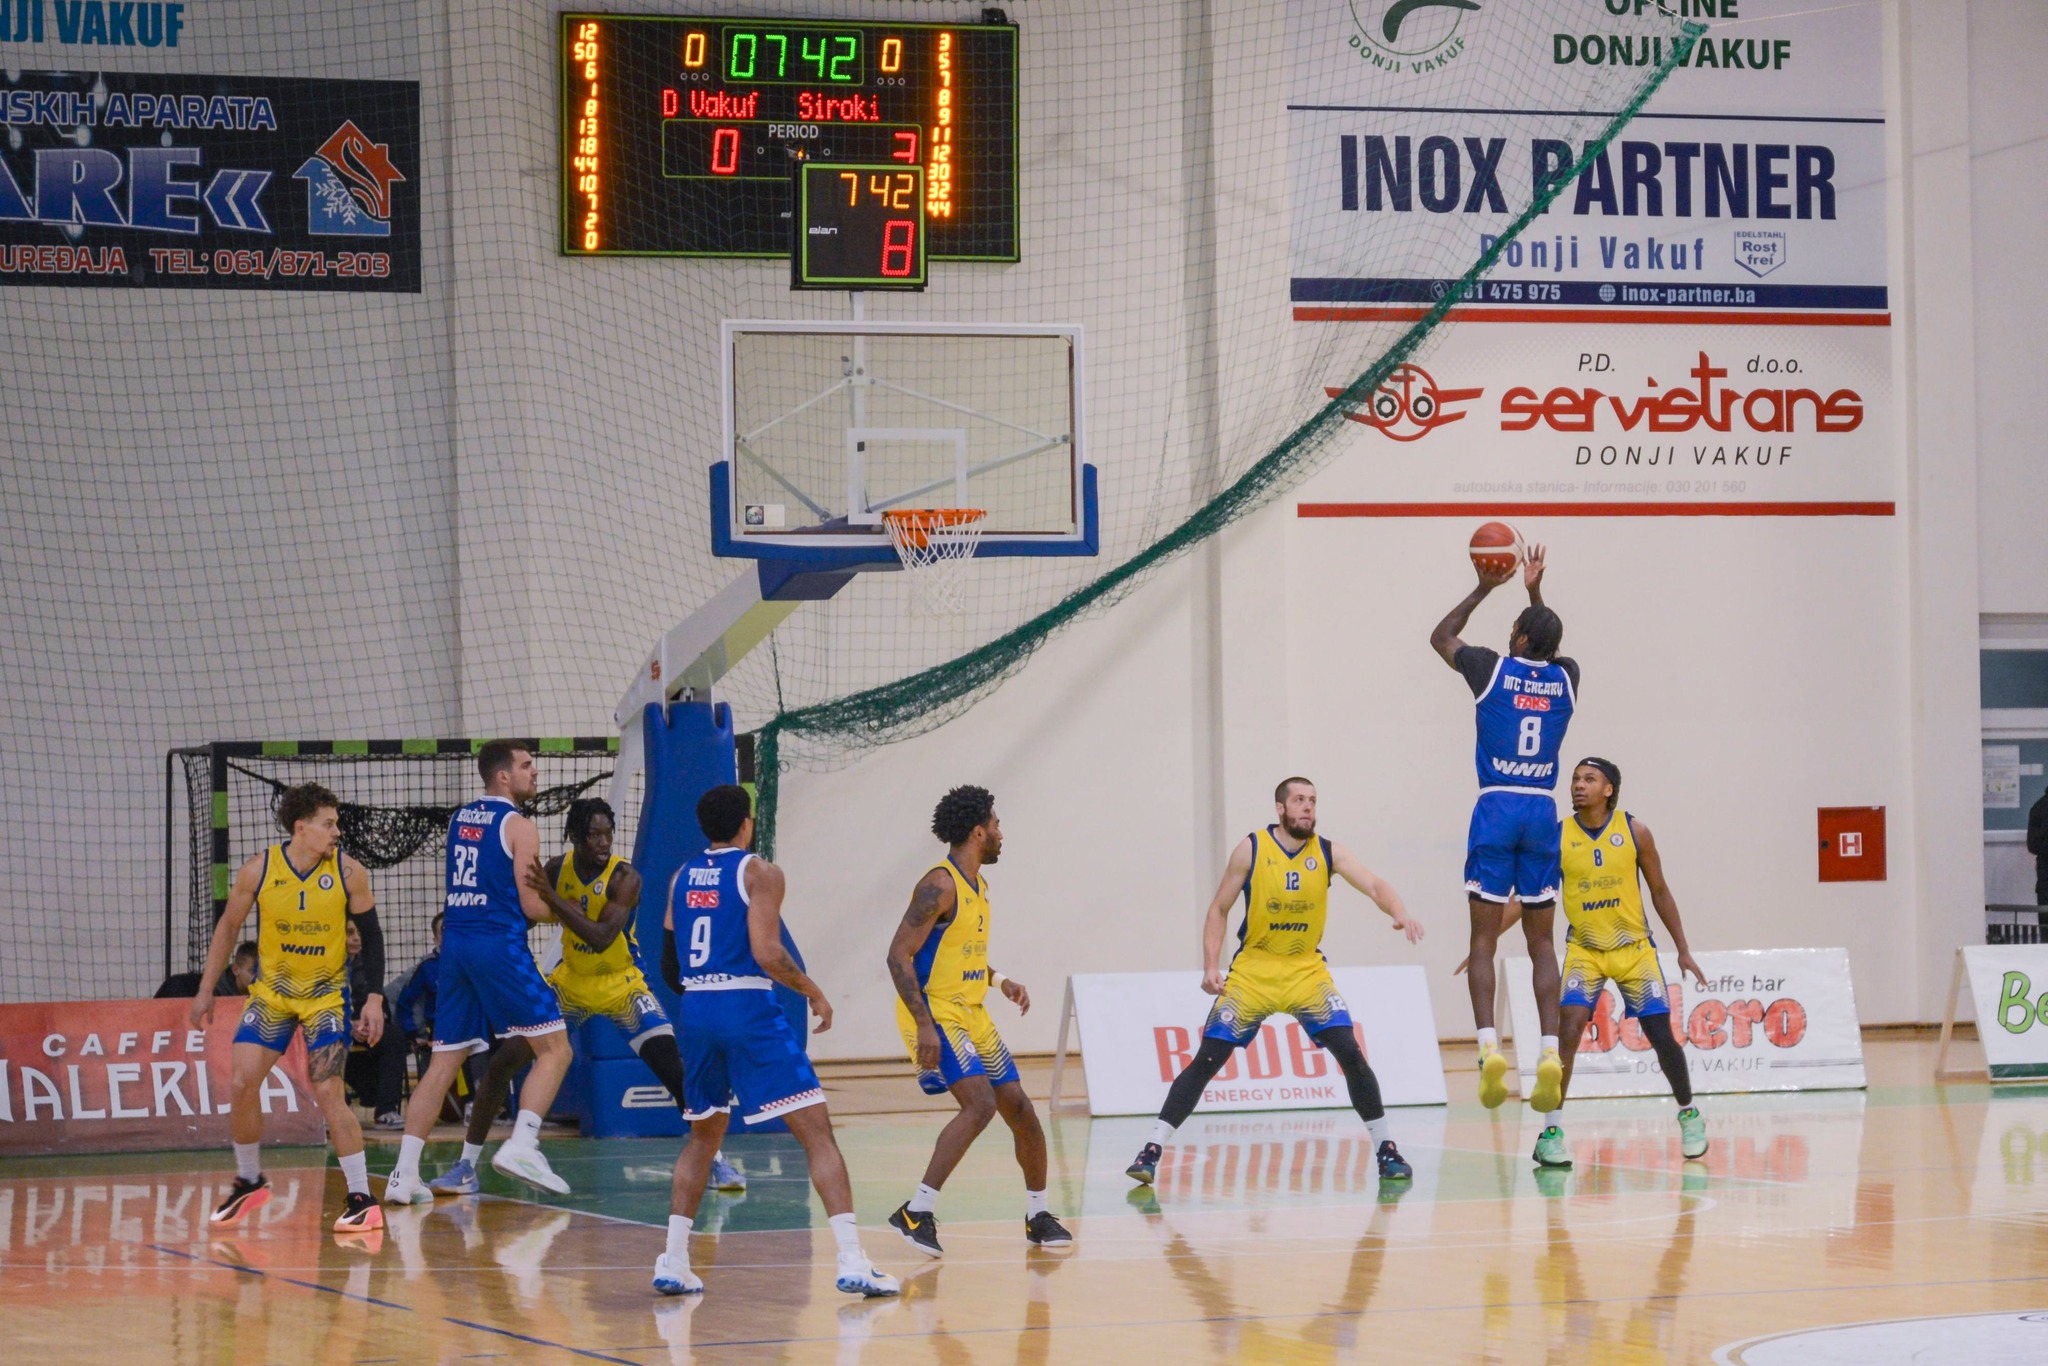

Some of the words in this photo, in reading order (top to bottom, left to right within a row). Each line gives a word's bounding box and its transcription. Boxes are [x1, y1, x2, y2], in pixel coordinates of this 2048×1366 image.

[54, 0, 184, 47] VAKUF
[580, 23, 598, 41] 12
[573, 42, 597, 61] 50
[939, 33, 951, 52] 3
[1553, 33, 1662, 67] DONJI
[1670, 36, 1791, 70] VAKUF
[685, 33, 705, 66] 0
[881, 39, 901, 72] 0
[938, 51, 950, 70] 5
[1348, 35, 1400, 73] DONJI
[1411, 37, 1467, 74] VAKUF
[585, 61, 597, 80] 6
[940, 70, 951, 87] 7
[663, 89, 678, 117] D
[690, 89, 759, 119] Vakuf
[799, 92, 880, 122] Siroki
[938, 88, 951, 107] 8
[104, 93, 277, 131] APARATA
[585, 99, 598, 117] 8
[939, 107, 951, 126] 9
[580, 118, 598, 136] 13
[768, 124, 819, 139] PERIOD
[580, 137, 598, 155] 18
[711, 129, 740, 173] 0
[933, 144, 951, 162] 12
[573, 157, 598, 172] 44
[928, 163, 951, 181] 30
[580, 175, 598, 192] 10
[1340, 134, 1508, 214] INOX
[1532, 138, 1837, 220] PARTNER
[928, 181, 951, 200] 32
[587, 193, 598, 210] 7
[927, 201, 951, 217] 44
[585, 212, 598, 230] 2
[808, 226, 838, 235] elan
[585, 231, 598, 250] 0
[1736, 230, 1784, 239] EDELSTAHL
[881, 220, 915, 276] 8
[1480, 233, 1579, 273] Donji
[1599, 236, 1705, 270] Vakuf
[1742, 241, 1777, 252] Rost
[150, 248, 209, 274] TEL:
[214, 248, 390, 280] 061/871-203
[1747, 253, 1773, 265] frei
[1490, 284, 1523, 300] 475
[1528, 284, 1561, 300] 975
[1622, 283, 1756, 305] inox-partner.ba
[1577, 352, 1616, 373] P.D.
[1746, 354, 1804, 374] d.o.o.
[1501, 351, 1864, 432] servistrans
[1575, 446, 1674, 466] DONJI
[1694, 446, 1793, 466] VAKUF
[1453, 480, 1523, 494] autobuska
[1666, 481, 1690, 493] 030
[1694, 481, 1717, 493] 201
[1722, 481, 1746, 493] 560
[1513, 695, 1551, 711] FAKS
[1518, 716, 1542, 757] 8
[453, 845, 479, 887] 32
[1594, 849, 1603, 867] 8
[1285, 872, 1300, 891] 12
[299, 890, 306, 911] 1
[977, 914, 984, 933] 2
[689, 916, 711, 968] 9
[1651, 982, 1661, 997] 8
[1695, 976, 1745, 993] caffe
[1752, 975, 1785, 991] bar
[637, 995, 657, 1014] 13
[330, 1017, 338, 1032] 1
[42, 1030, 206, 1057] CAFFE
[1636, 1060, 1694, 1074] DOI
[1702, 1058, 1765, 1072] VAKUF
[0, 1058, 299, 1123] ALERIA
[1204, 1088, 1275, 1103] ENERGY
[1280, 1086, 1336, 1101] DRINK
